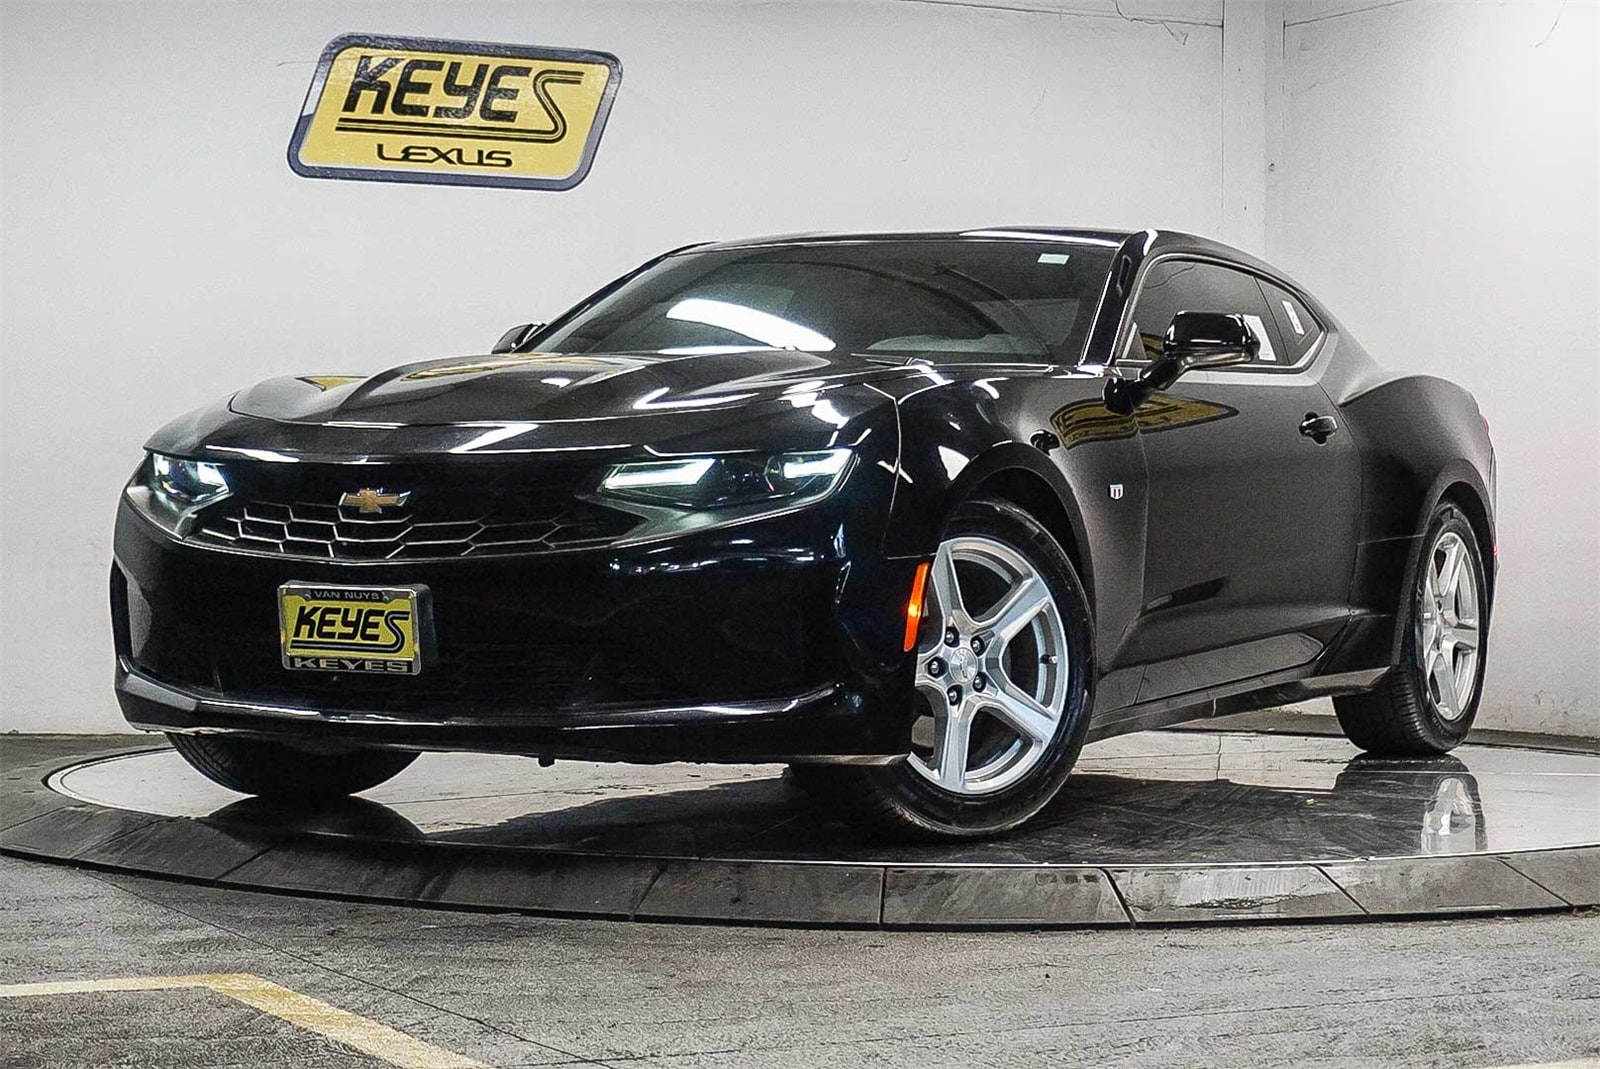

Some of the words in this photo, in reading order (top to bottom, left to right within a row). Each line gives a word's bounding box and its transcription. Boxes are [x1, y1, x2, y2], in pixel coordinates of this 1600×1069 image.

[335, 55, 585, 144] KEYES
[376, 143, 513, 168] LEXUS
[314, 590, 341, 599] VAN
[344, 591, 380, 600] NUYS
[290, 605, 410, 654] KEYES
[294, 657, 408, 673] KEYES
